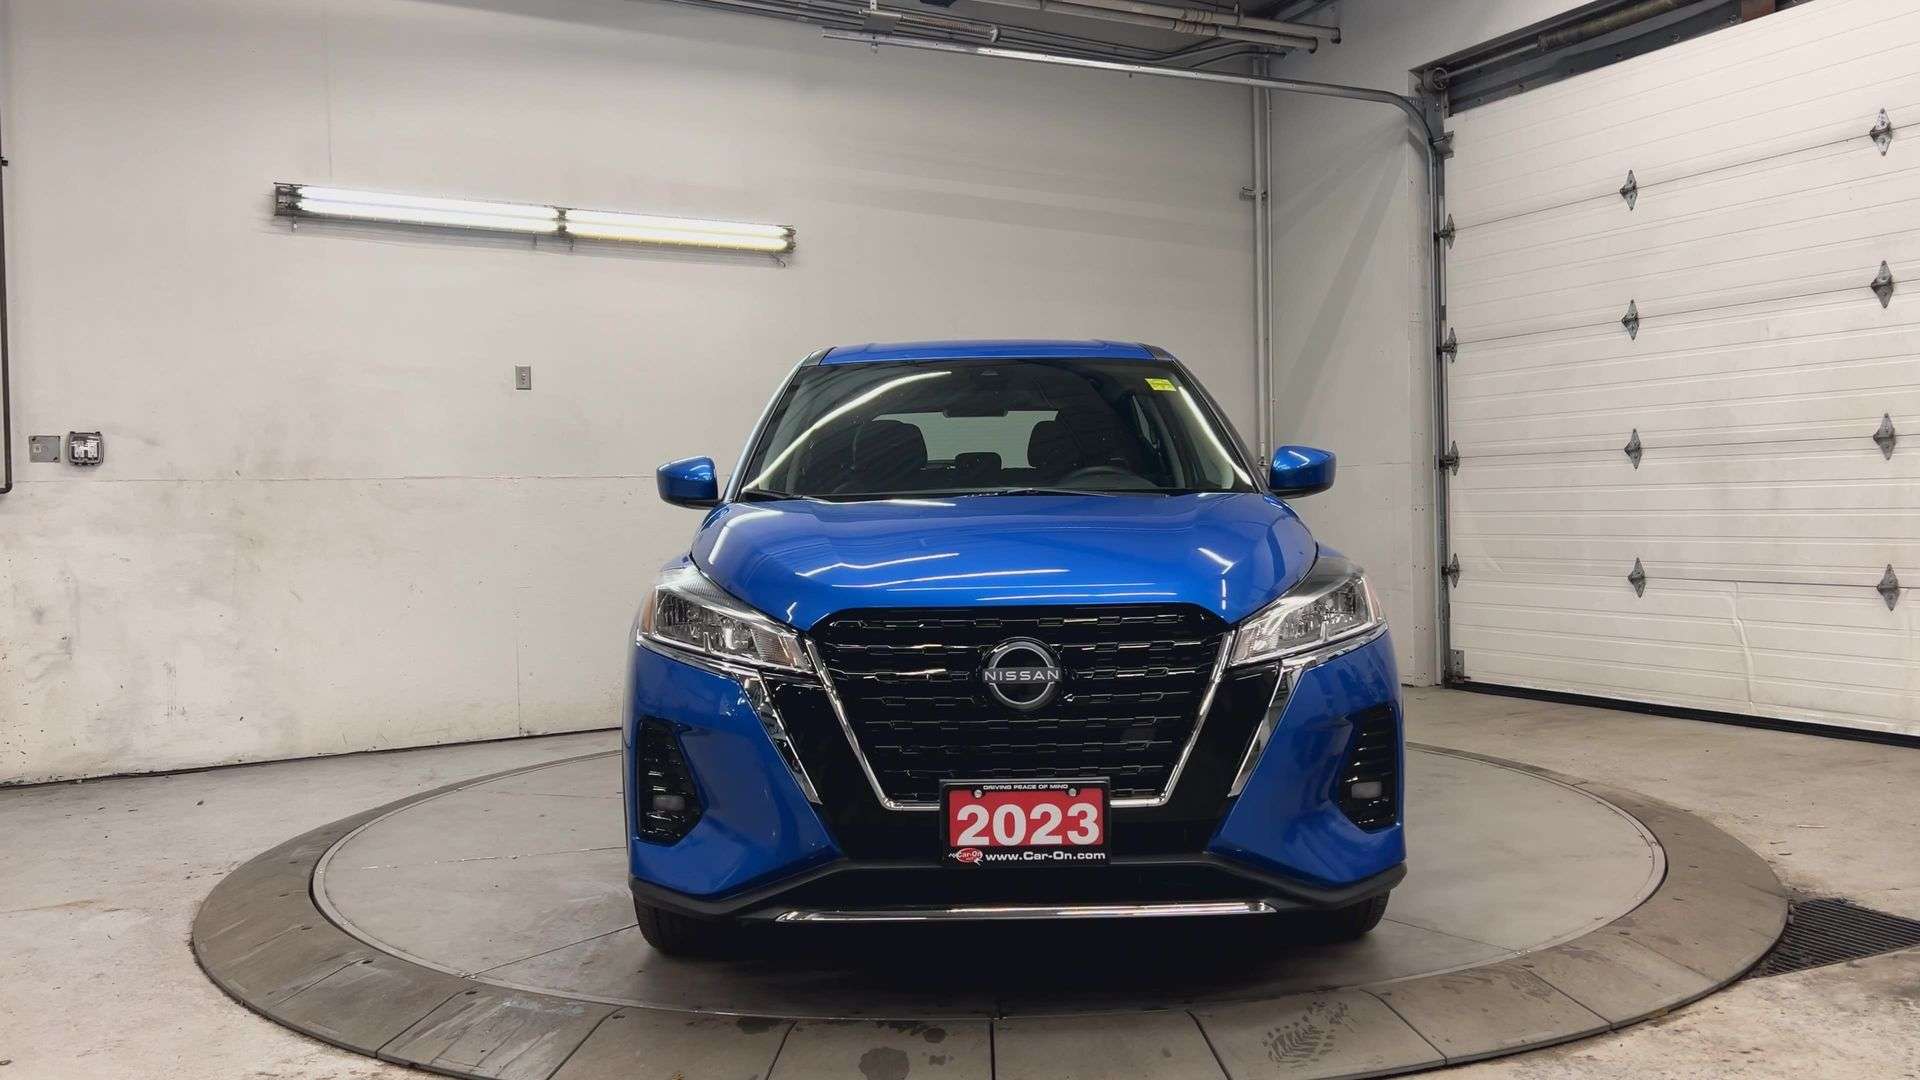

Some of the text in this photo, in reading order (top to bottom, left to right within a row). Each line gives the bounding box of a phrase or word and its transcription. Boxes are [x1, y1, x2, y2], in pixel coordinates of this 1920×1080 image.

[984, 670, 1059, 681] NISSAN
[957, 803, 1100, 846] 2023
[985, 850, 1106, 861] www.Car-On.com
